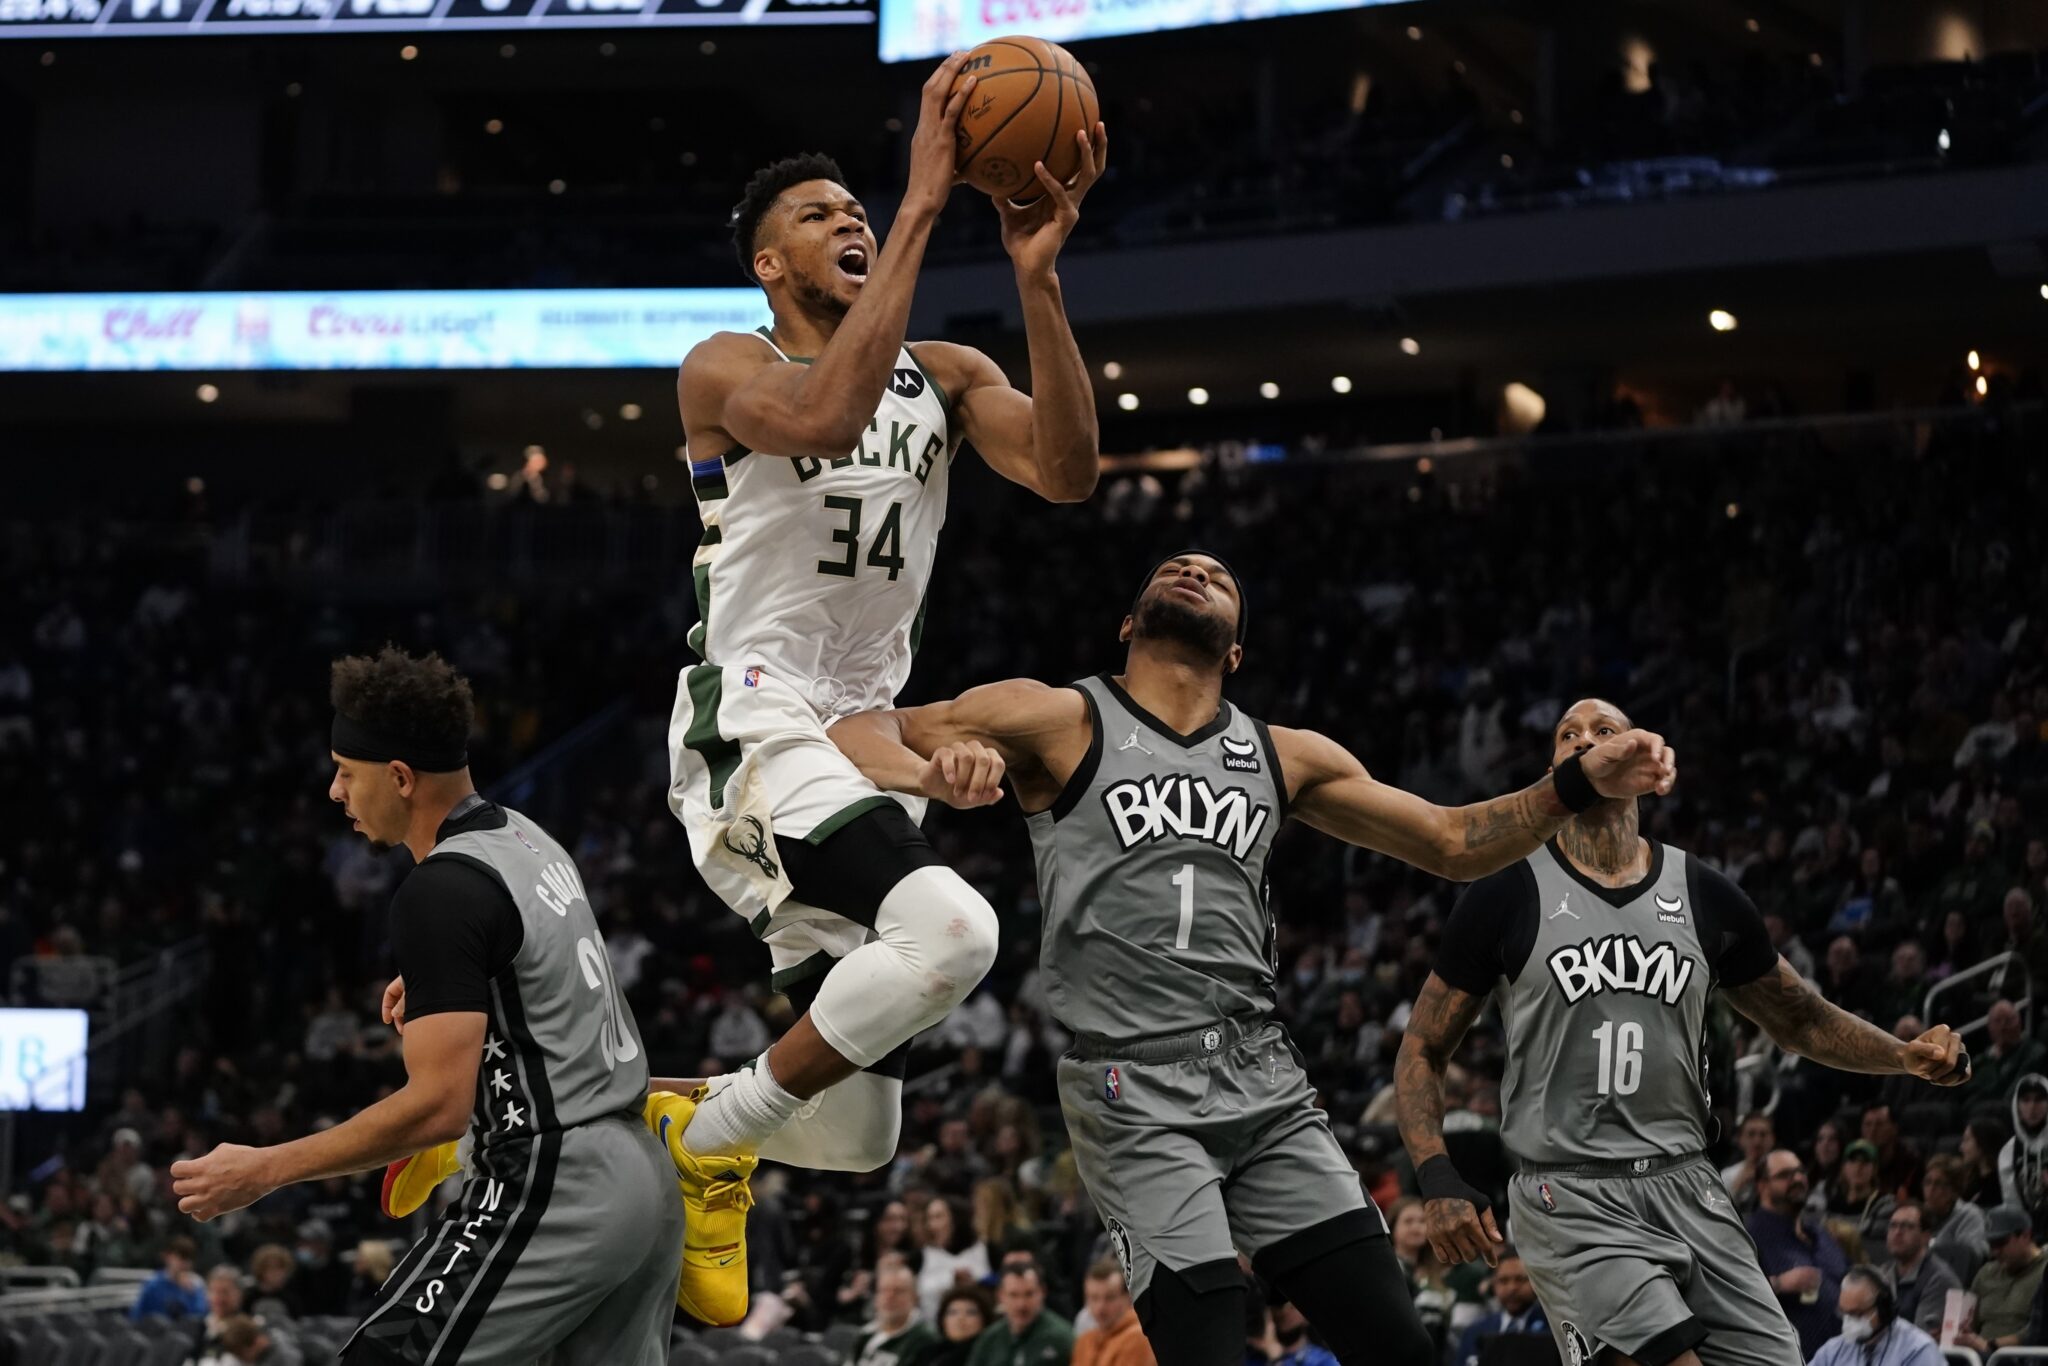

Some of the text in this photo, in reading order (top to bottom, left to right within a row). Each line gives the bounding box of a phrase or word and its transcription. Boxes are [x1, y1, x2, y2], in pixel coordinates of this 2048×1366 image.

[790, 417, 944, 487] BCKS
[817, 495, 904, 581] 34
[1226, 757, 1258, 770] Webull
[1104, 775, 1268, 861] BKLYN
[1172, 864, 1194, 949] 1
[1658, 912, 1685, 924] Webull
[1549, 936, 1694, 1006] BKLYN
[1592, 1020, 1644, 1096] 16
[415, 1177, 504, 1313] NETS
